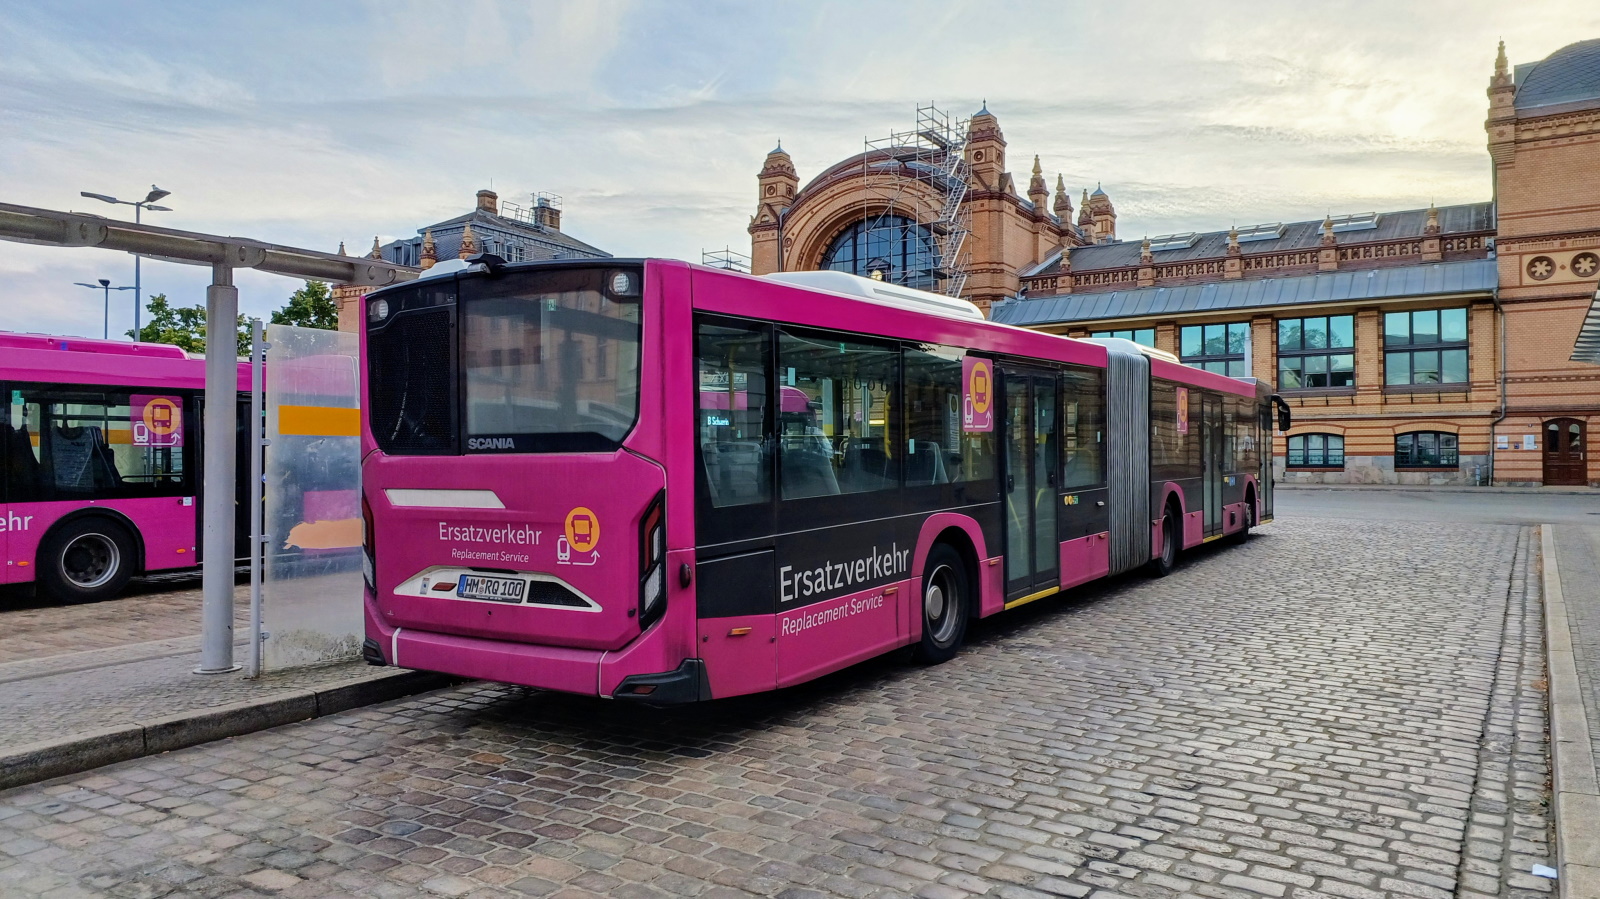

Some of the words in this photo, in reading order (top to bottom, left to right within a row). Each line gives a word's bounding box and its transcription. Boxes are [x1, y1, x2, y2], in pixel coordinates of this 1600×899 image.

[468, 437, 515, 450] SCANIA
[439, 521, 542, 545] Ersatzverkehr
[451, 548, 499, 561] Replacement
[500, 550, 529, 563] Service
[780, 542, 909, 603] Ersatzverkehr
[464, 578, 480, 593] HM
[484, 579, 500, 595] RQ
[500, 580, 522, 597] 100
[781, 601, 849, 637] Replacement
[849, 593, 883, 616] Service
